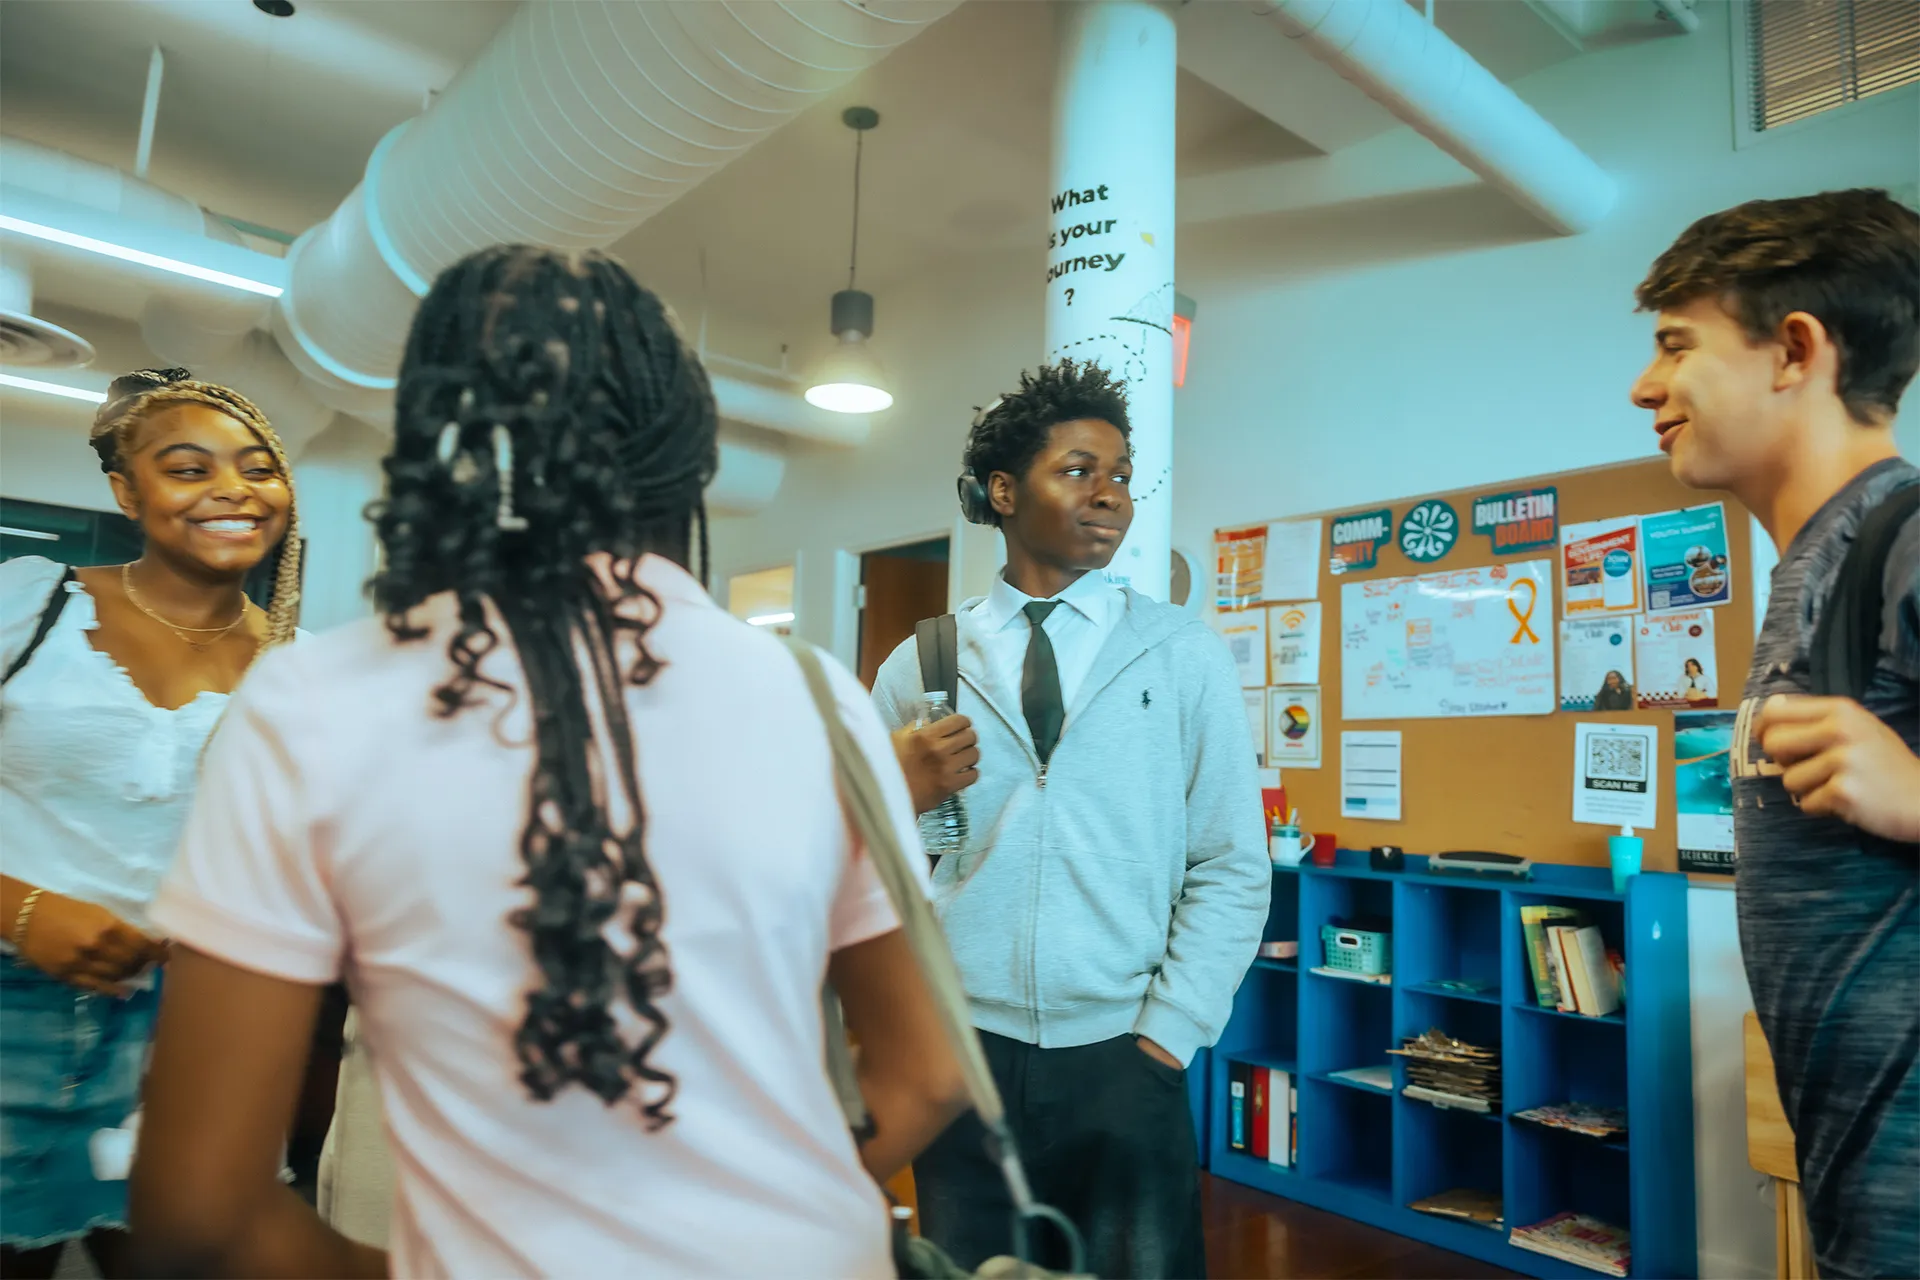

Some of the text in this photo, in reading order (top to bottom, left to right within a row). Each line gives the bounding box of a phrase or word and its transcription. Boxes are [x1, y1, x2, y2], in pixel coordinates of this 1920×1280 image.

[1051, 184, 1108, 214] What
[1060, 219, 1117, 247] your
[1046, 252, 1126, 283] ourney
[1064, 287, 1075, 306] ?
[1475, 493, 1554, 526] BULLETIN
[1333, 516, 1389, 544] COMM-
[1495, 518, 1553, 547] BOARD
[1592, 779, 1640, 792] SCAN ME
